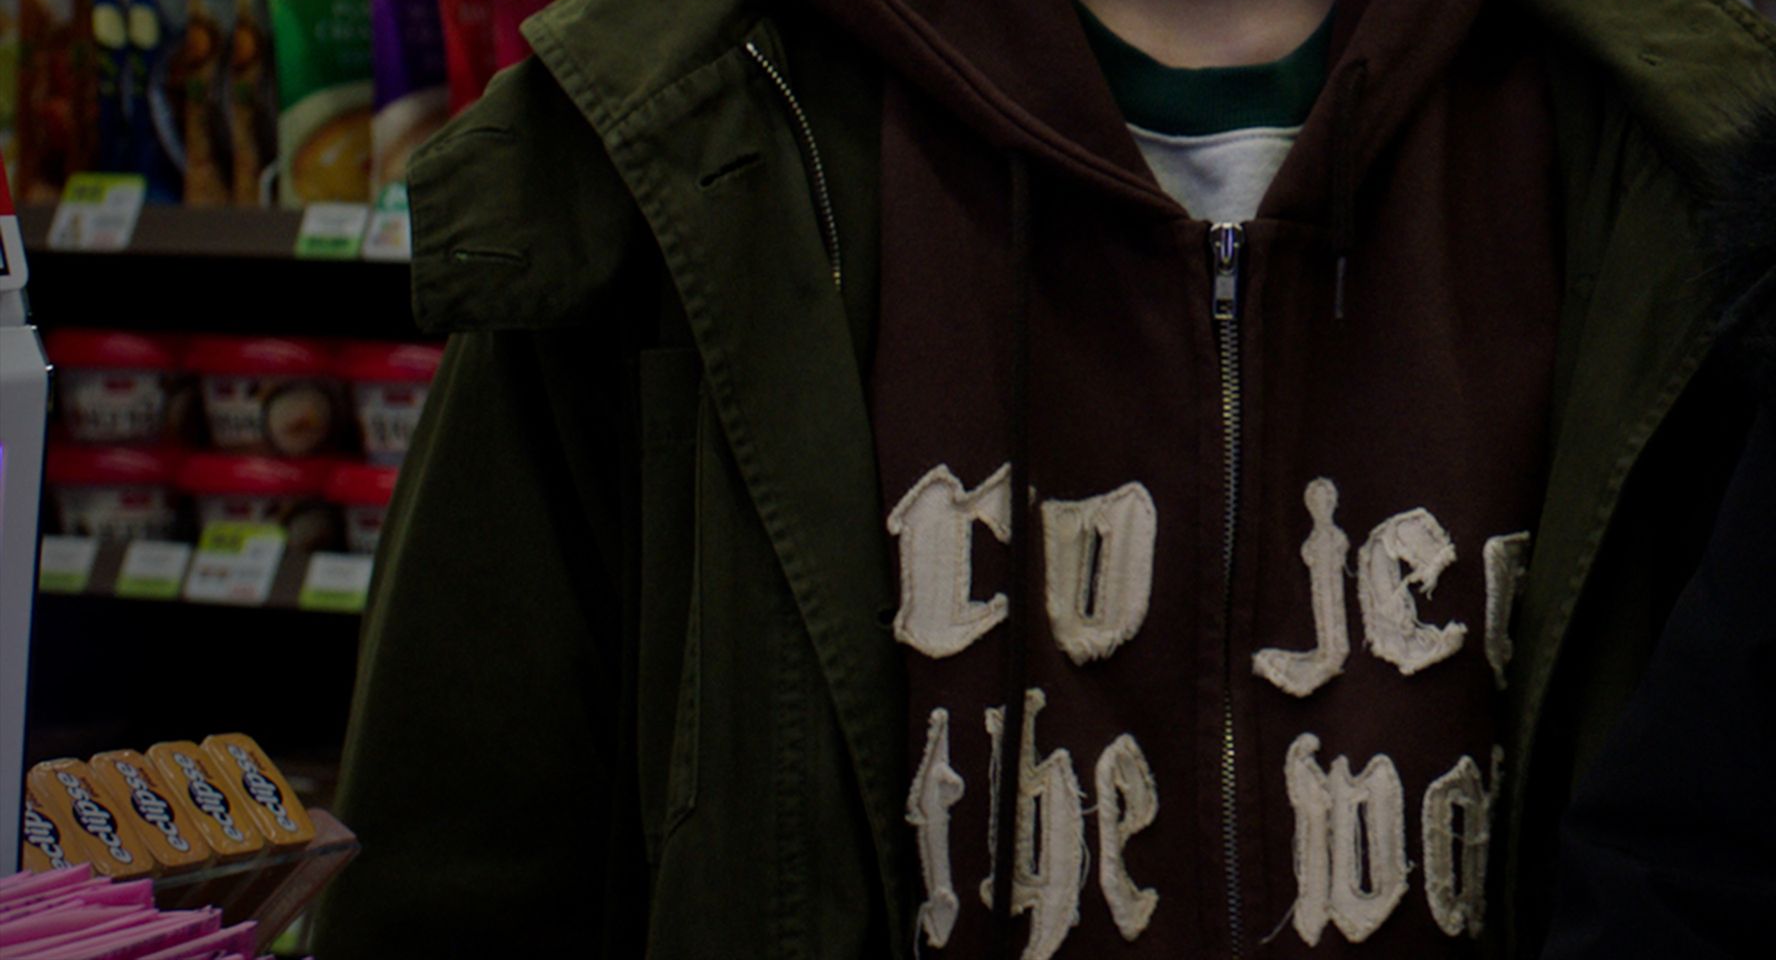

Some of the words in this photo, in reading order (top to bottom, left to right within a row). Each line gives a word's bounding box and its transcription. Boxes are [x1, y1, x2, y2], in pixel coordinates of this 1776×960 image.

[56, 770, 133, 865] eclipse
[115, 759, 191, 853] eclipse
[172, 751, 244, 842] eclipse
[227, 743, 298, 833] eclipse
[24, 800, 73, 870] eclip
